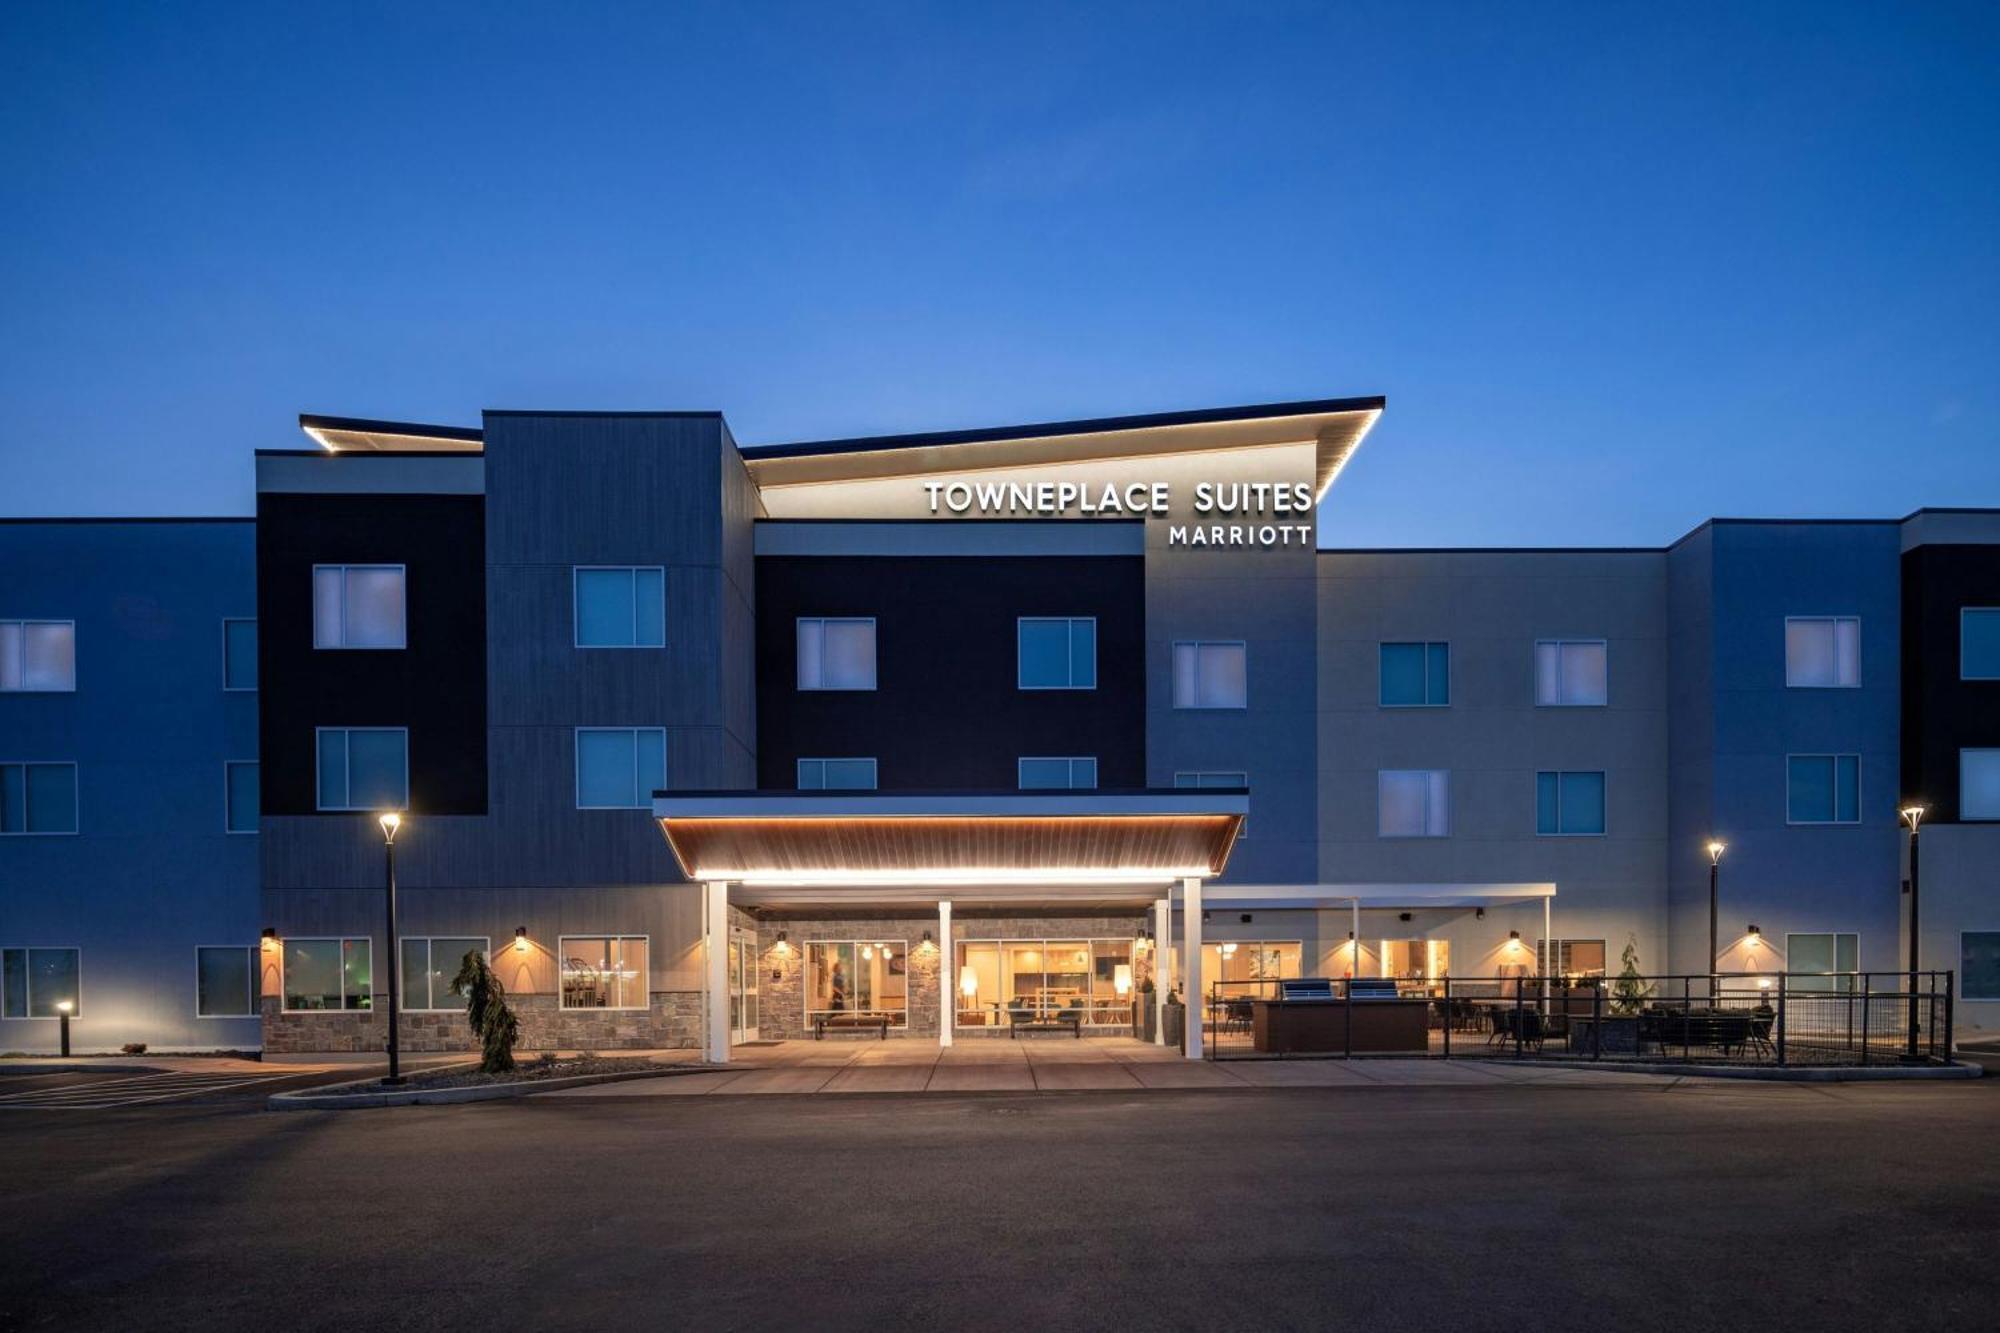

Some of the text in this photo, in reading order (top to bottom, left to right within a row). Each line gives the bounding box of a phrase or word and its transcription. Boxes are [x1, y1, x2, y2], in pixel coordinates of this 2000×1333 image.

[925, 482, 1313, 513] TOWNEPLACE SUITES
[1169, 525, 1312, 545] MARRIOTT
